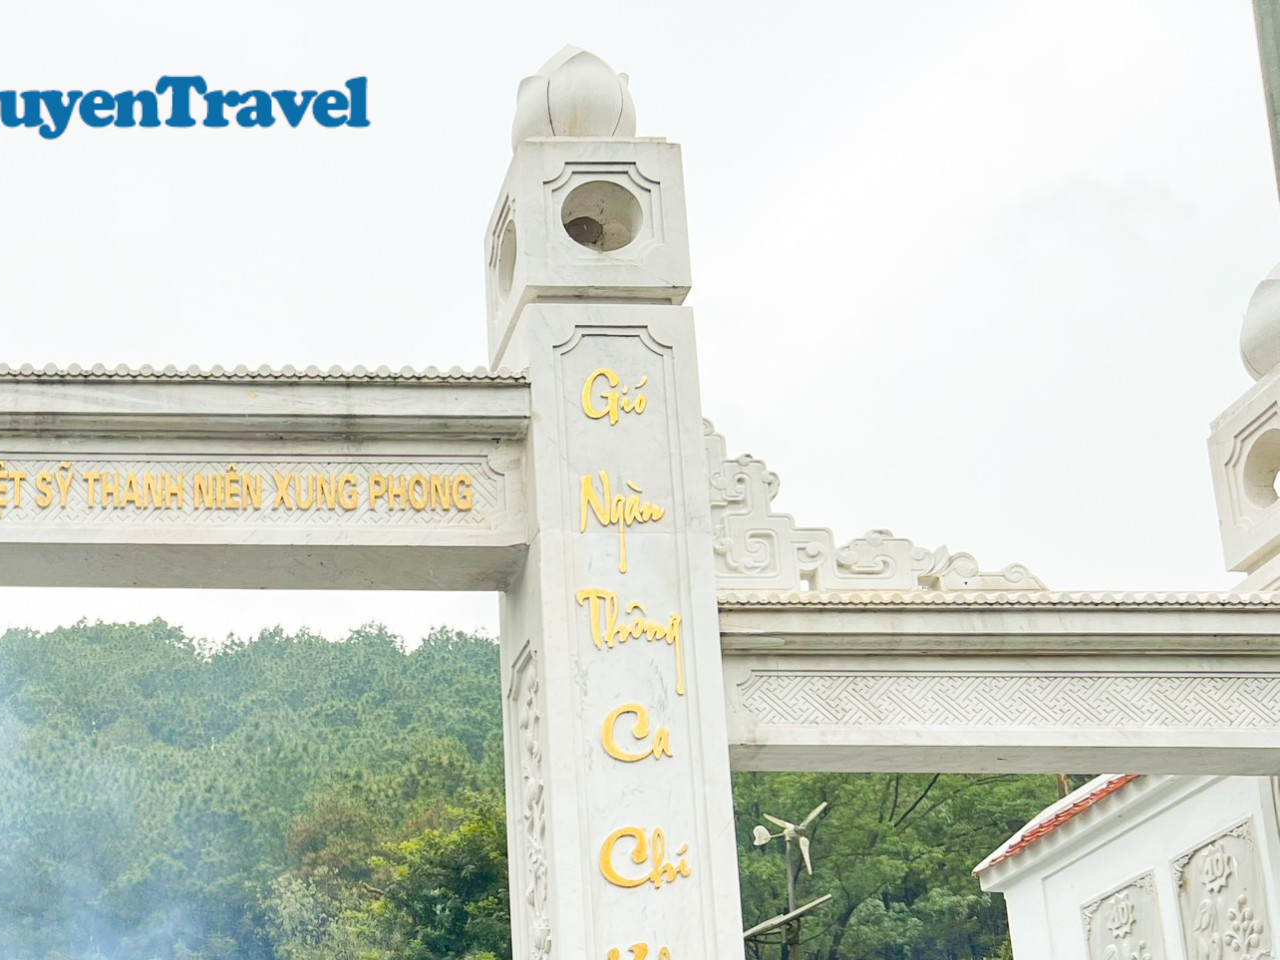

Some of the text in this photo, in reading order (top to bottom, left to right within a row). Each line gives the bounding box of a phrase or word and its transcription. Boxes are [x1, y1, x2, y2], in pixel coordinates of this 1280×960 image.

[582, 368, 647, 426] Gió
[36, 461, 74, 509] SỸ
[81, 471, 184, 509] THANH
[193, 463, 263, 509] NIÊN
[273, 472, 359, 510] XUNG
[368, 472, 473, 511] PHONG
[581, 471, 665, 573] Ngàn
[576, 588, 685, 695] Thông
[602, 704, 671, 762] Ca
[599, 826, 691, 888] Chí
